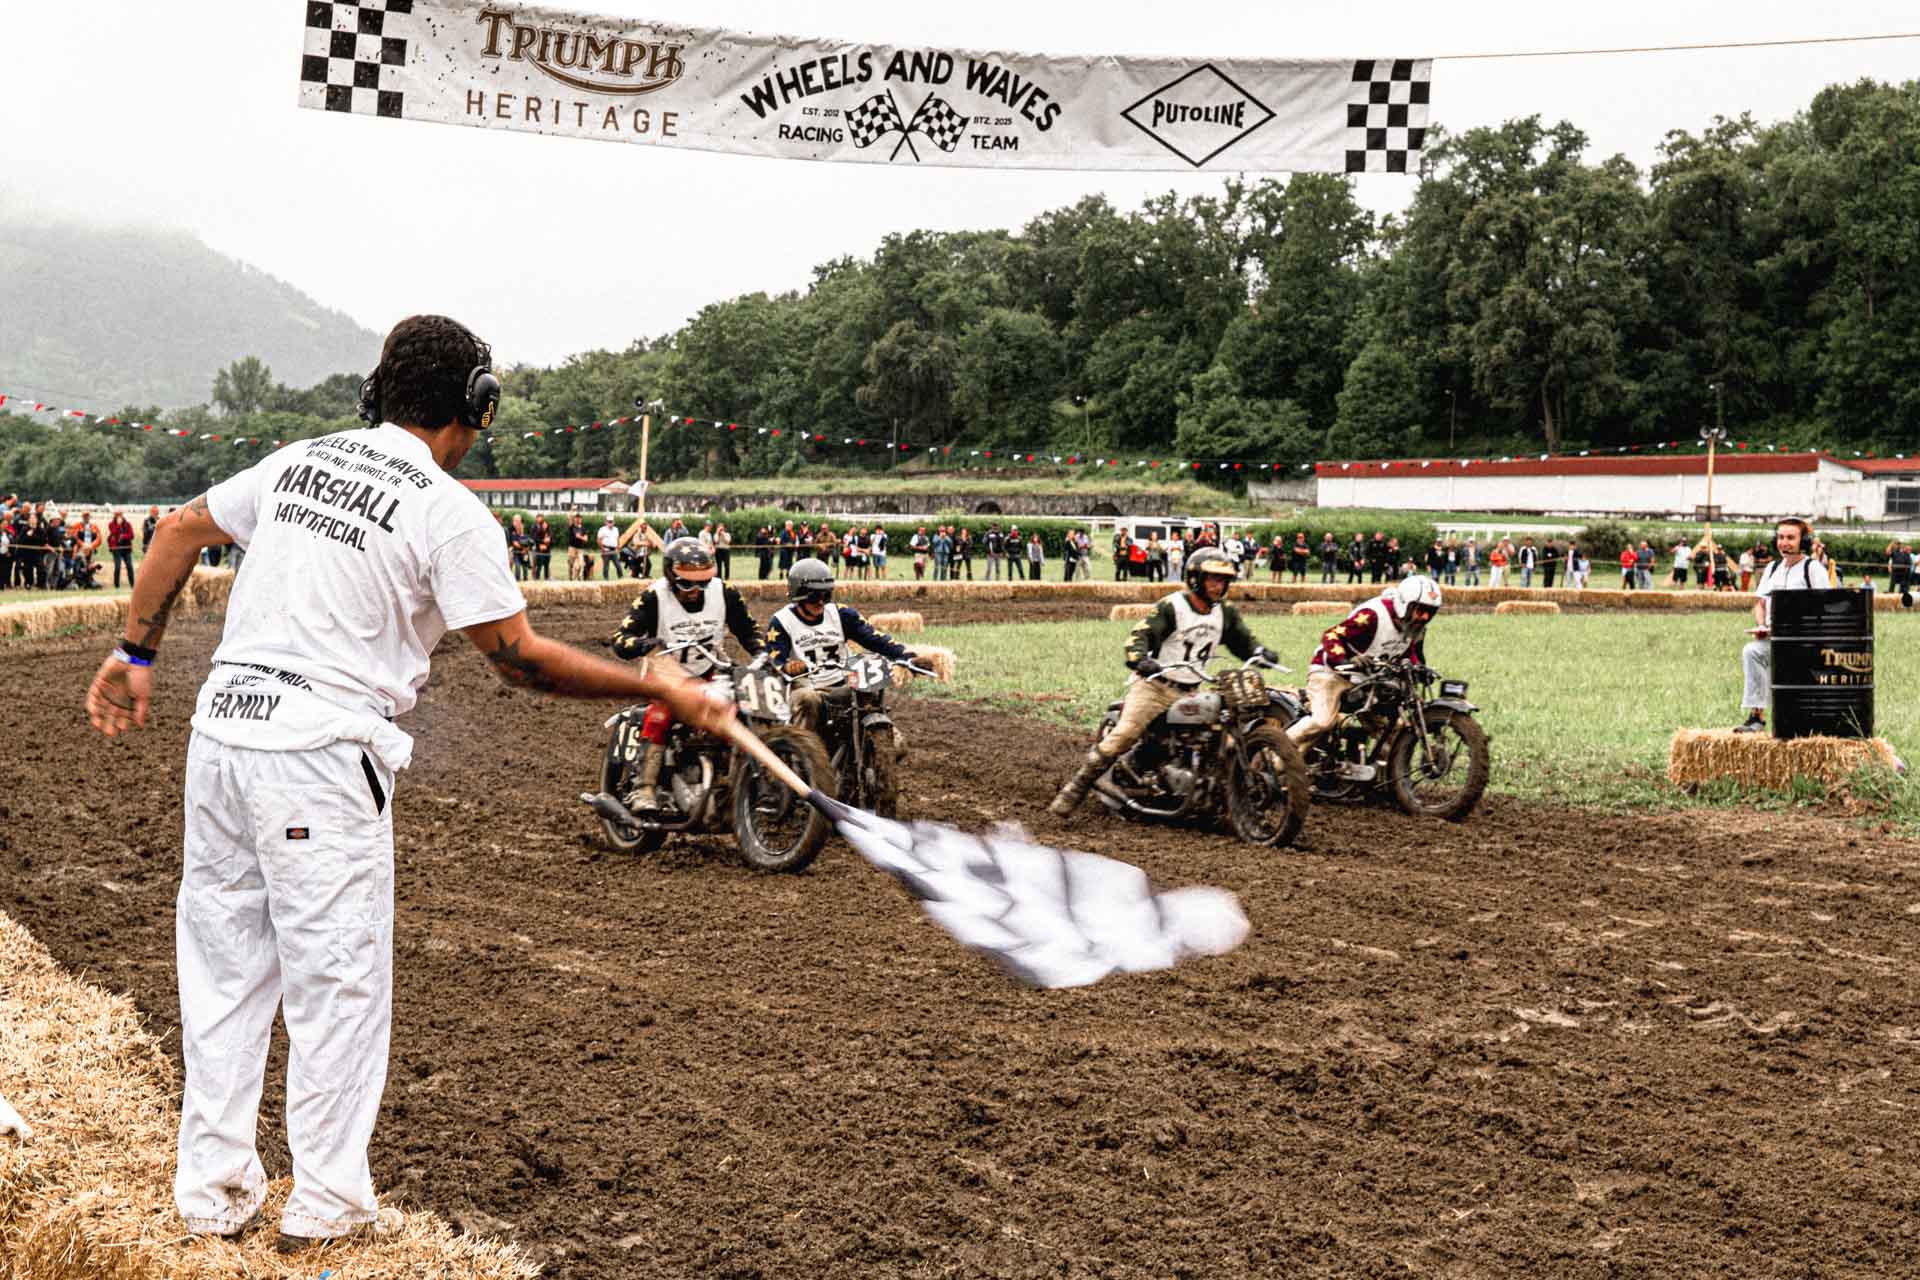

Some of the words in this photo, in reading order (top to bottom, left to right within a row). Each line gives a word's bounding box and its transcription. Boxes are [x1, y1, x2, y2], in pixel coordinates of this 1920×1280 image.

[477, 8, 685, 81] TRIUMPH
[740, 52, 873, 119] WHEELS
[884, 51, 954, 84] AND
[966, 59, 1062, 132] WAVES
[466, 88, 679, 137] HERITAGE
[802, 107, 820, 117] EST.
[823, 109, 839, 117] 2012
[1152, 99, 1246, 128] PUTOLINE
[778, 124, 843, 143] RACING
[971, 135, 1019, 150] TEAM
[306, 450, 332, 461] BACH
[331, 456, 349, 470] AVE
[384, 456, 433, 489] WAVES
[274, 502, 309, 525] 14TH
[1183, 640, 1213, 668] 14
[851, 656, 885, 689] 13
[208, 692, 281, 721] FAMILY
[736, 672, 786, 714] 16
